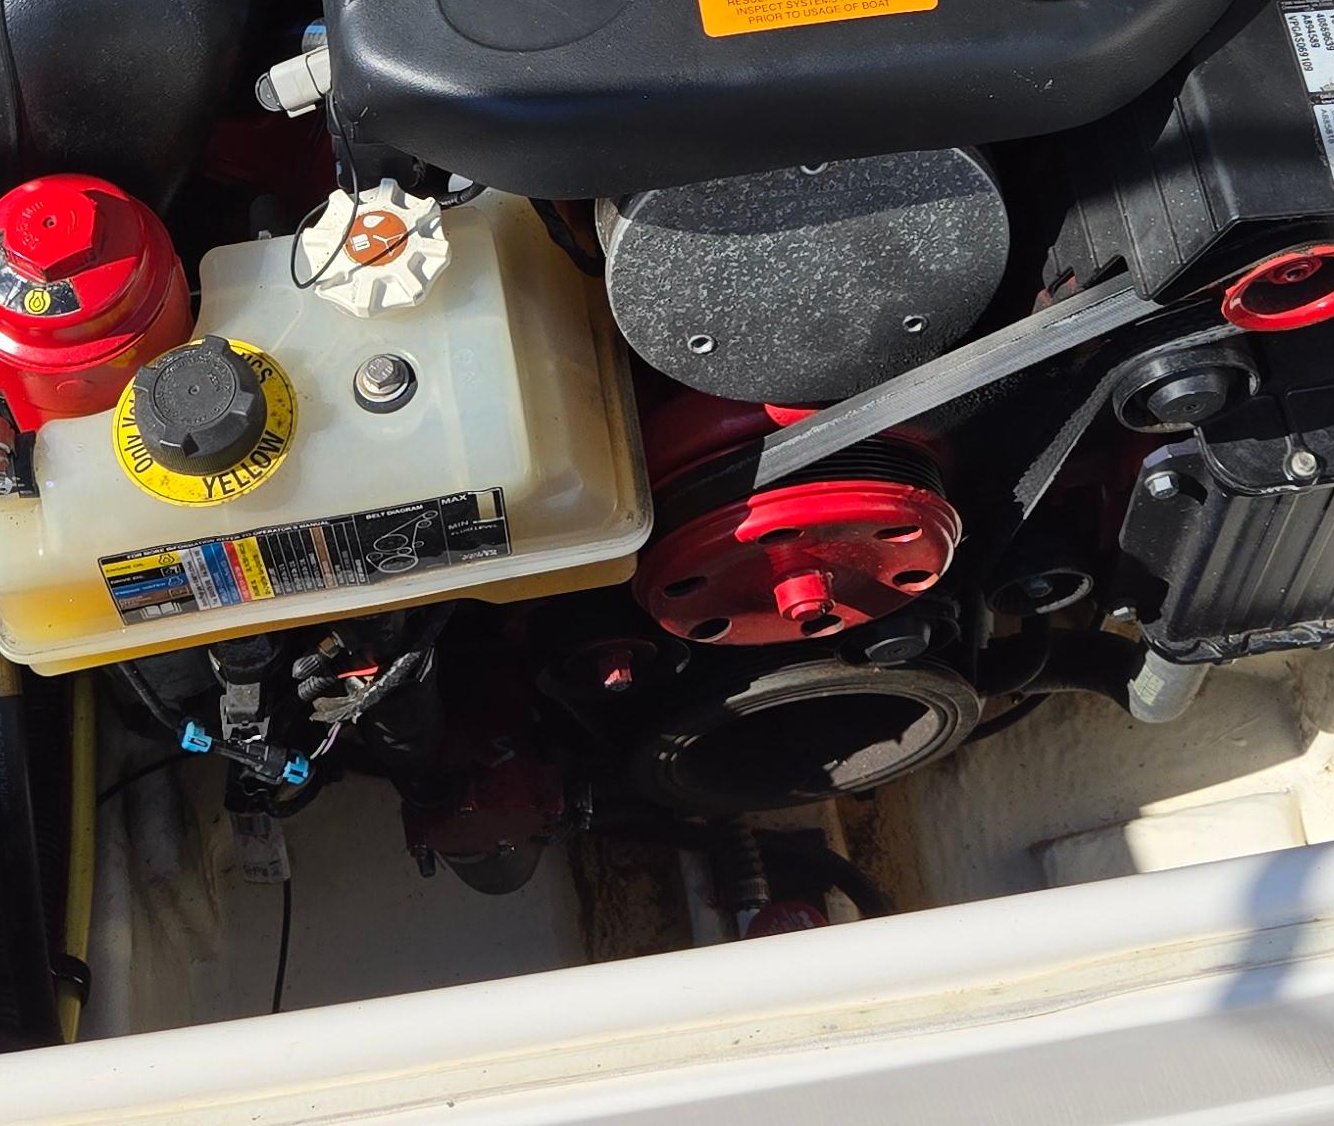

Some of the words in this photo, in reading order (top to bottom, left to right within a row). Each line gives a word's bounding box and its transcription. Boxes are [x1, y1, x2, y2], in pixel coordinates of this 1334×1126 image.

[736, 3, 784, 16] INSPECT
[748, 12, 783, 24] PRIOR
[785, 10, 801, 20] TO
[803, 5, 842, 18] USAGE
[844, 3, 860, 13] OF
[124, 434, 154, 474] Only
[202, 429, 285, 499] YELLOW
[441, 494, 467, 505] MAX
[365, 510, 386, 520] BELT
[387, 504, 424, 517] DIAGRAM
[448, 520, 468, 530] MIN
